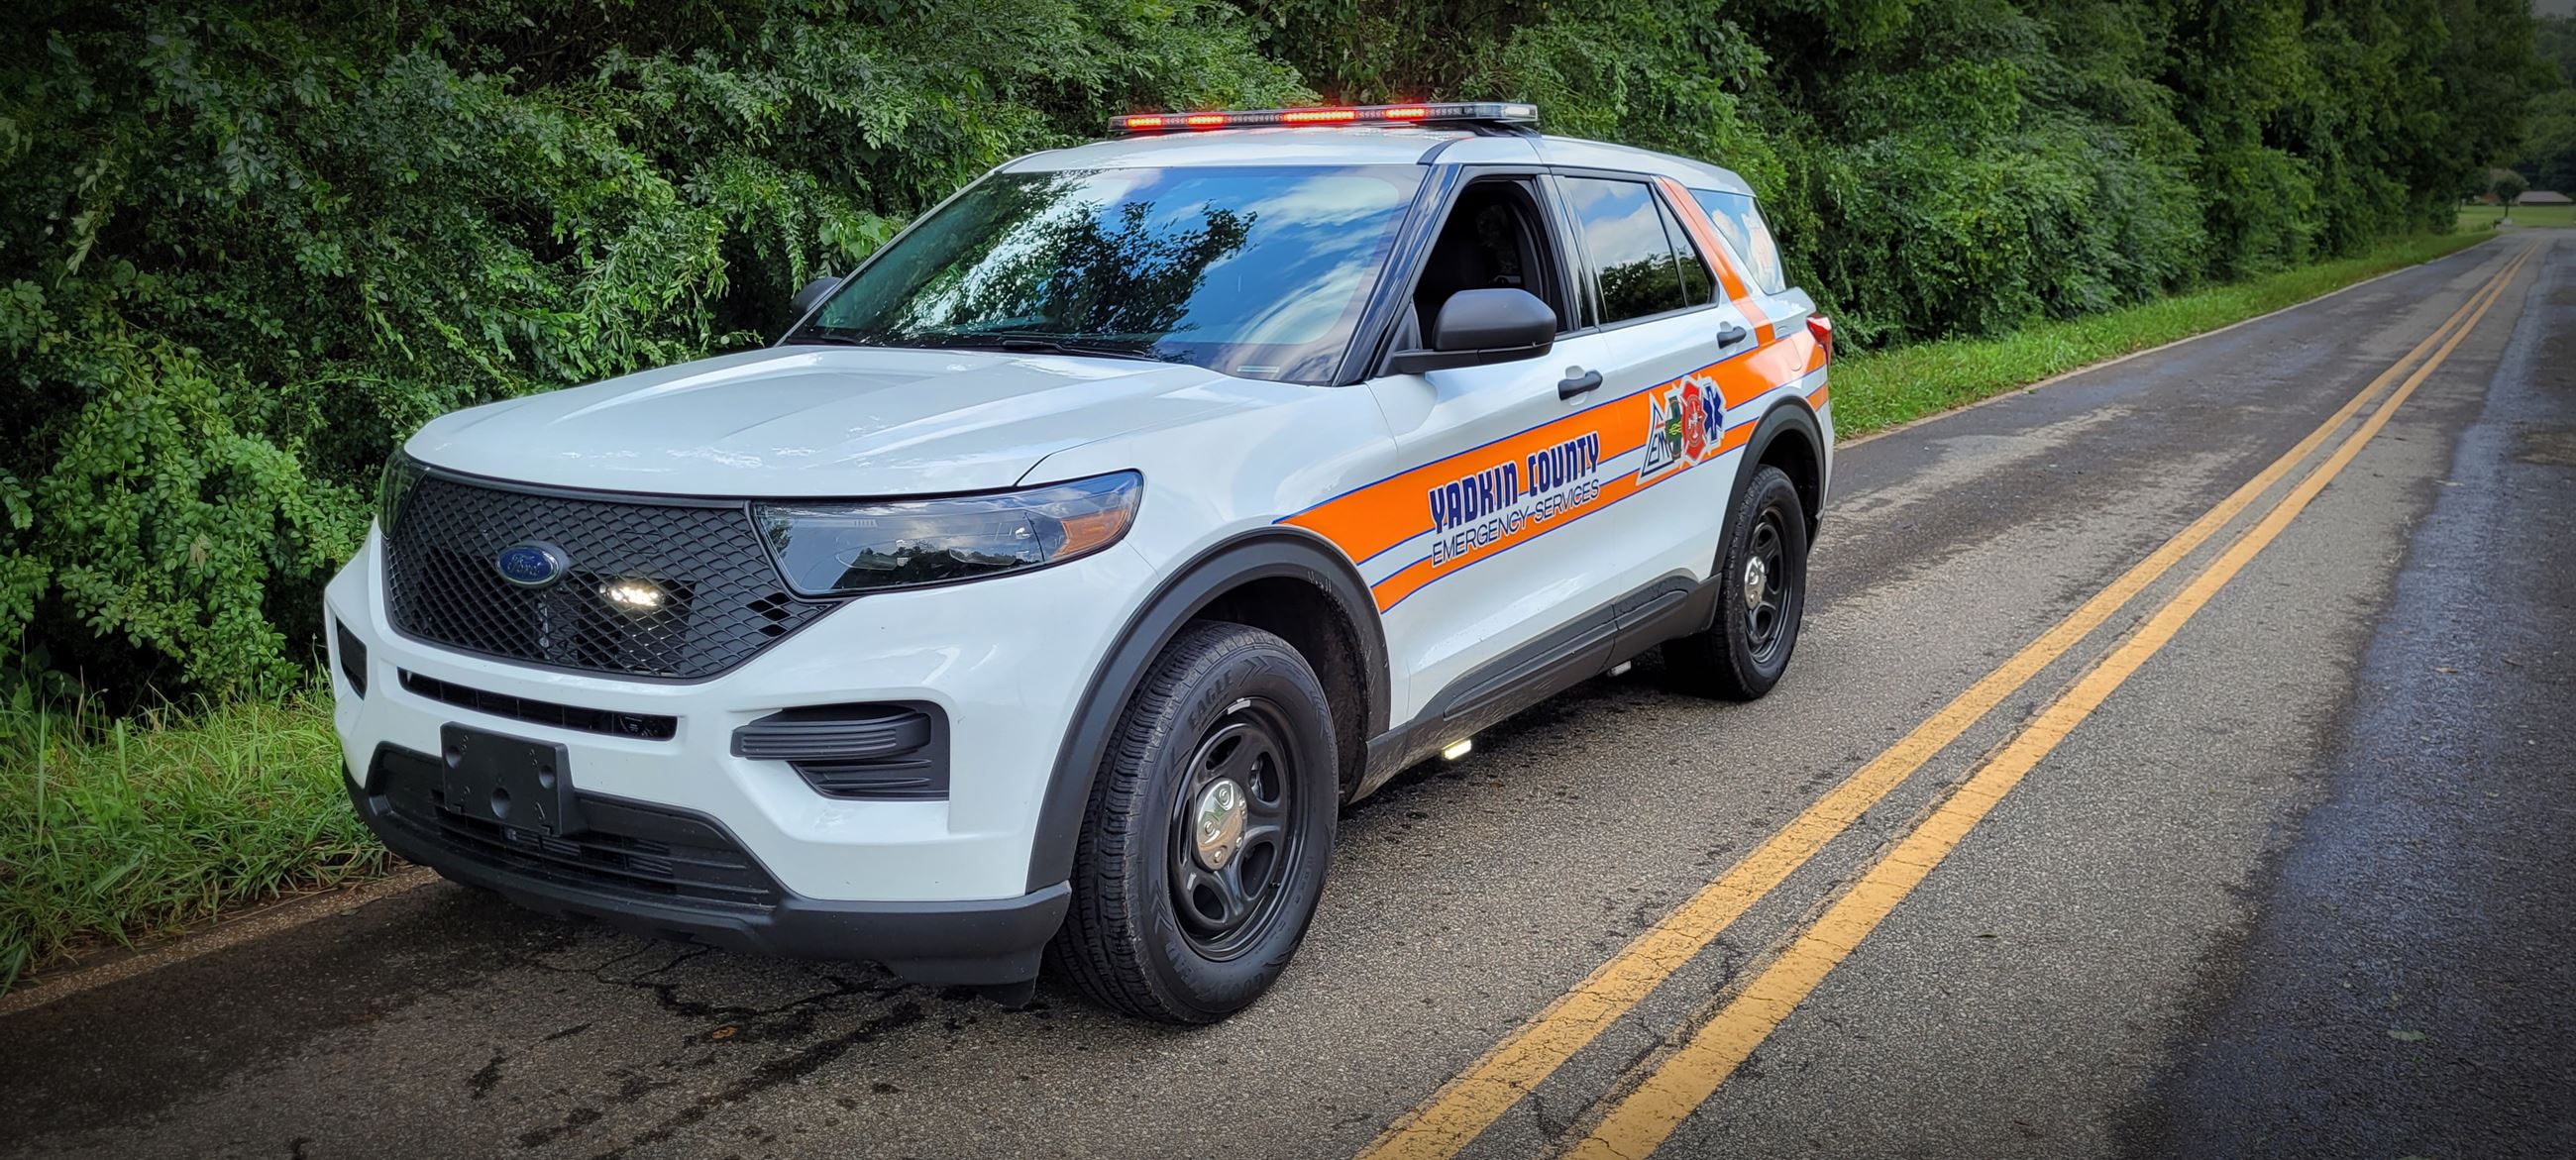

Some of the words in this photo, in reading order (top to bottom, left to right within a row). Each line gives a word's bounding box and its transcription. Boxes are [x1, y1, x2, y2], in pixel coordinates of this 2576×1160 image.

[1429, 462, 1518, 535] YADKIN
[1528, 433, 1599, 497] COUNTY
[1433, 506, 1529, 566] EMERGENCY
[1535, 478, 1599, 521] SERVICES
[506, 553, 542, 578] Ford
[1187, 670, 1234, 731] EAGLE
